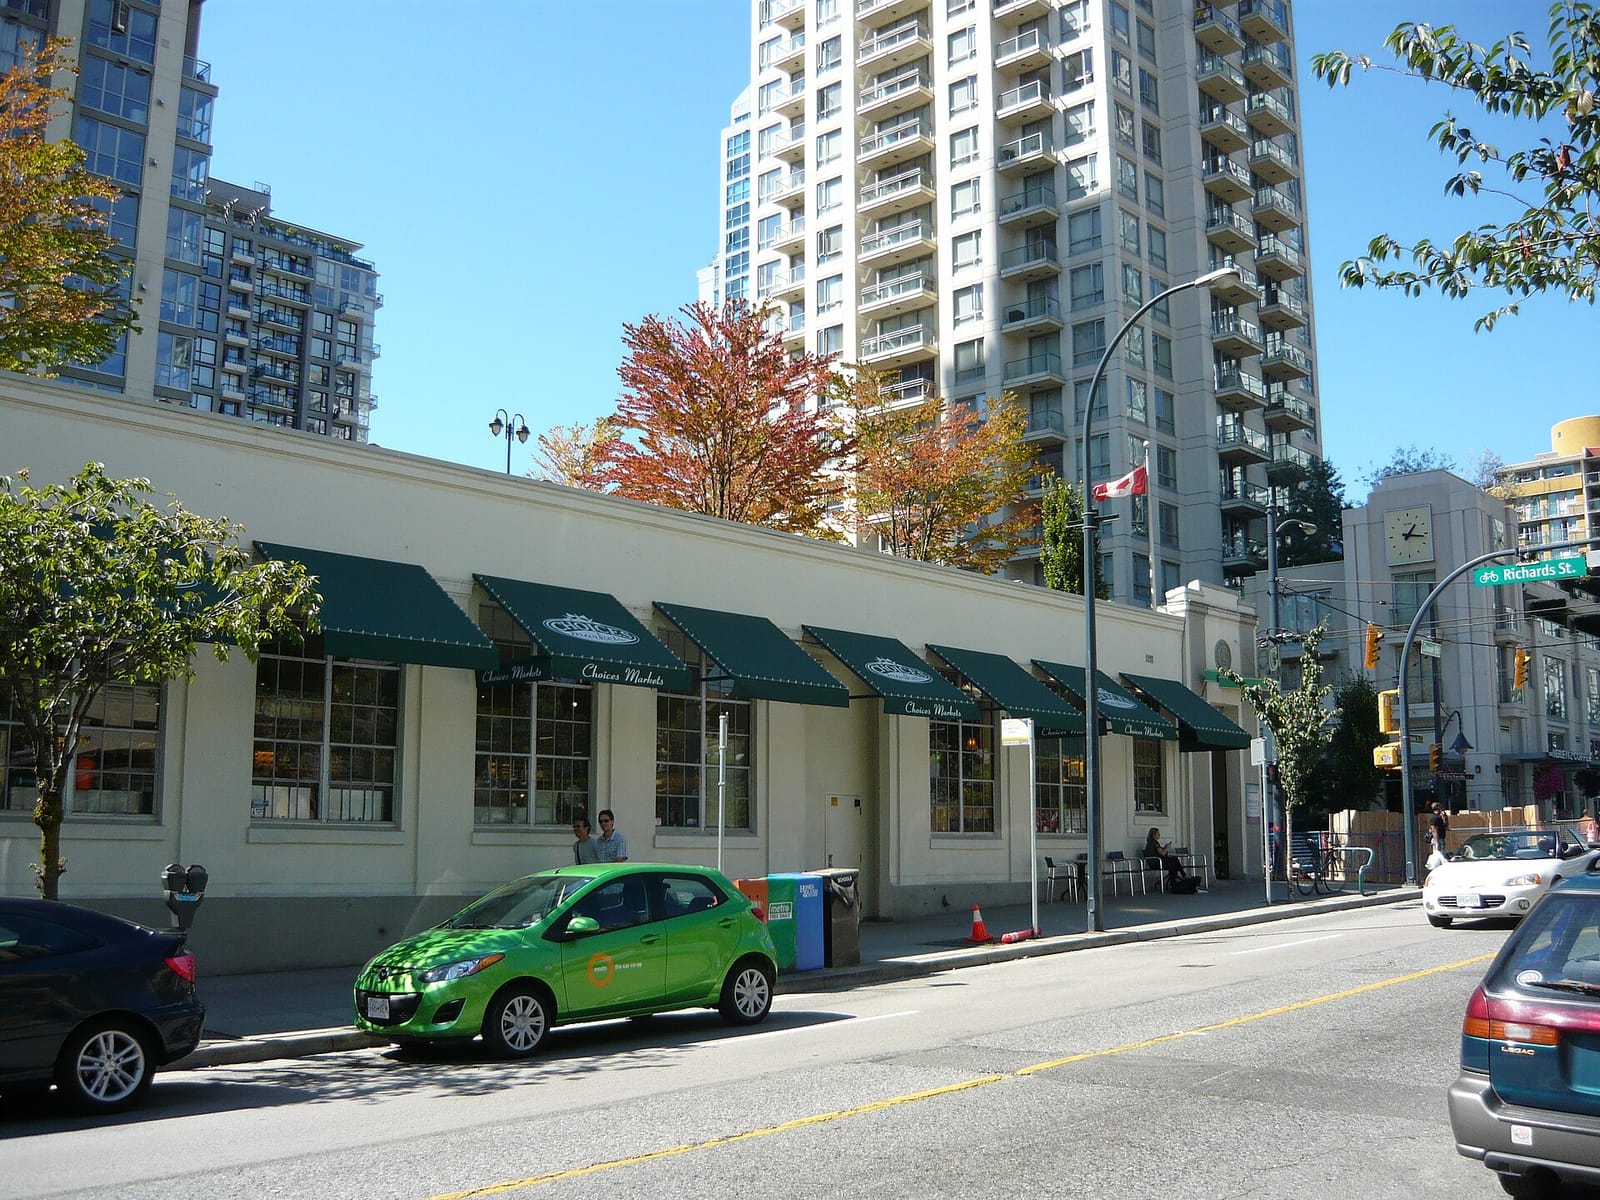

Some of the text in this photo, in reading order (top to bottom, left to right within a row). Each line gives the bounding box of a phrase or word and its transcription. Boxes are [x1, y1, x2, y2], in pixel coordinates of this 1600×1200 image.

[1503, 562, 1576, 580] Richards St.
[550, 620, 633, 639] CHOICES
[482, 665, 542, 683] Choices Markets
[582, 663, 664, 686] Choices Markets
[905, 700, 962, 717] Choices Markets
[771, 903, 790, 913] metro
